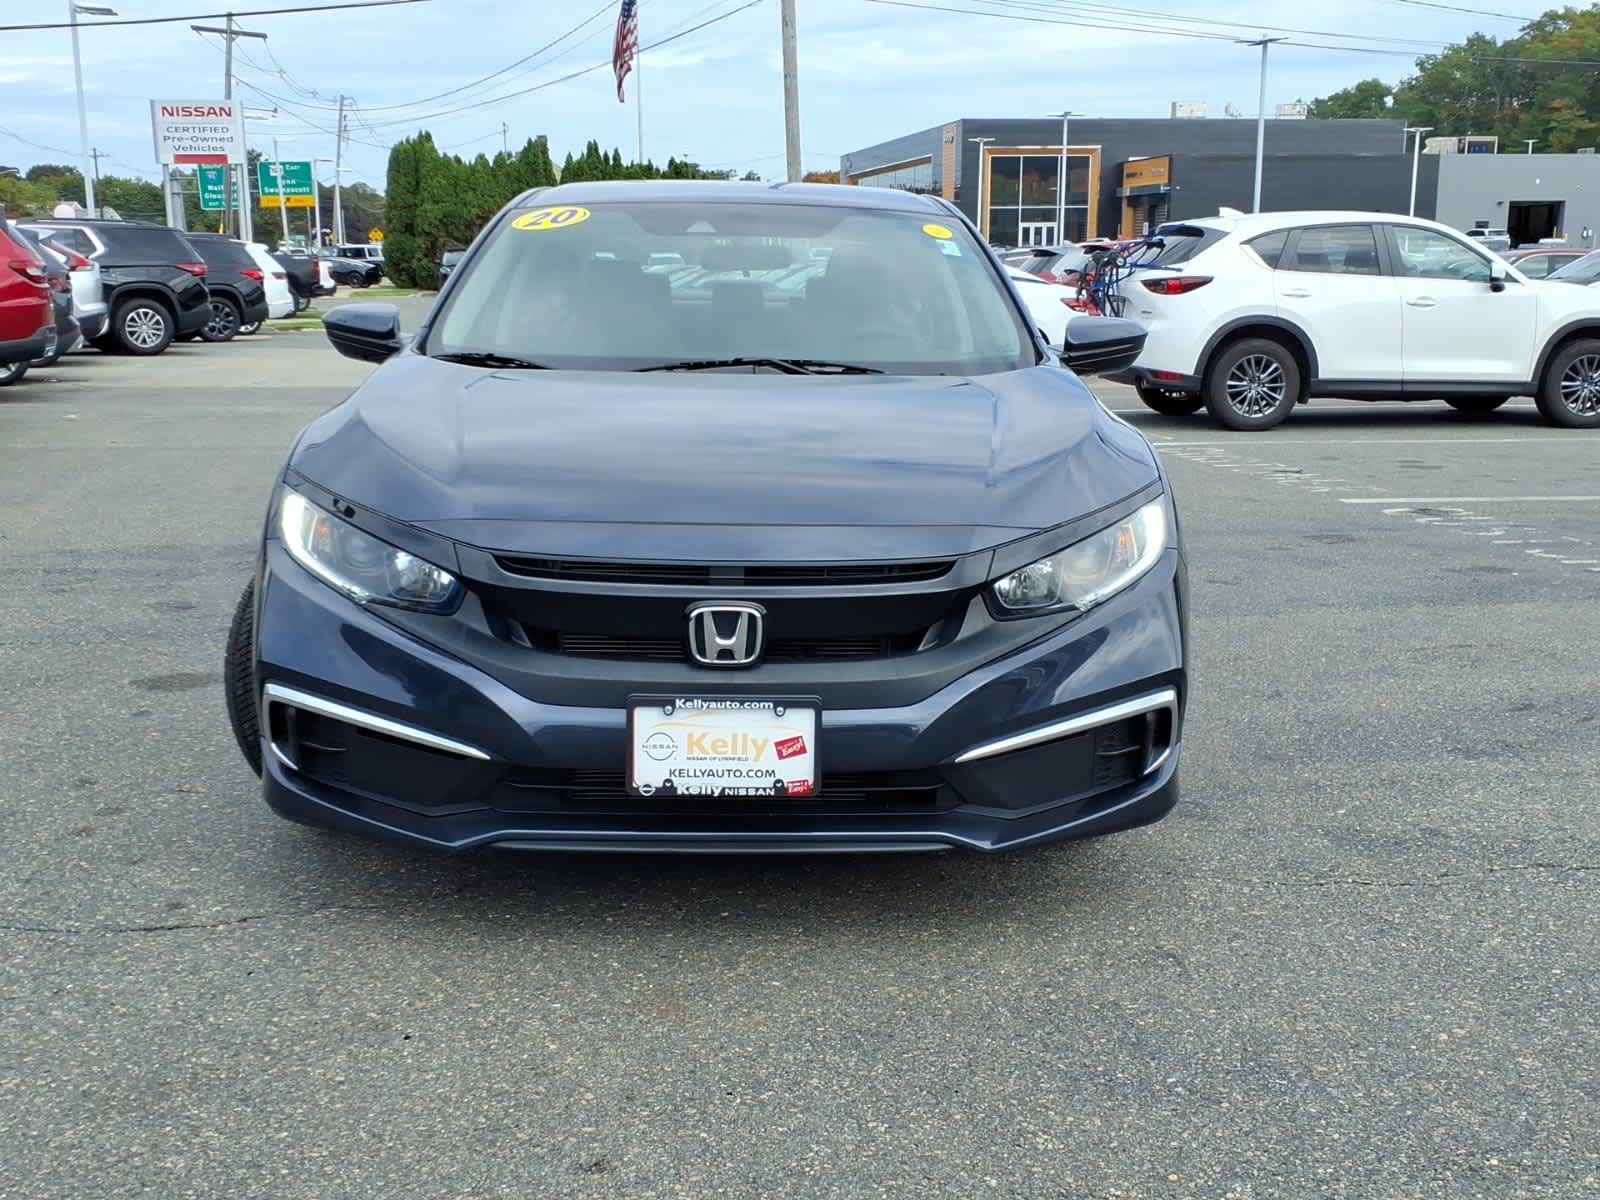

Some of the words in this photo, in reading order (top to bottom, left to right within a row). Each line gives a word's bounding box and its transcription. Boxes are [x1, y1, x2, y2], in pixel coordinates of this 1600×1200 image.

[161, 106, 231, 117] NISSAN
[173, 144, 225, 152] Vehicles
[522, 209, 578, 227] 20
[675, 699, 774, 711] Kellyauto.com
[686, 732, 769, 762] Kelly
[669, 768, 776, 778] KELLYAUTO.COM
[676, 783, 722, 797] Kelly
[725, 788, 774, 796] NISSAN
